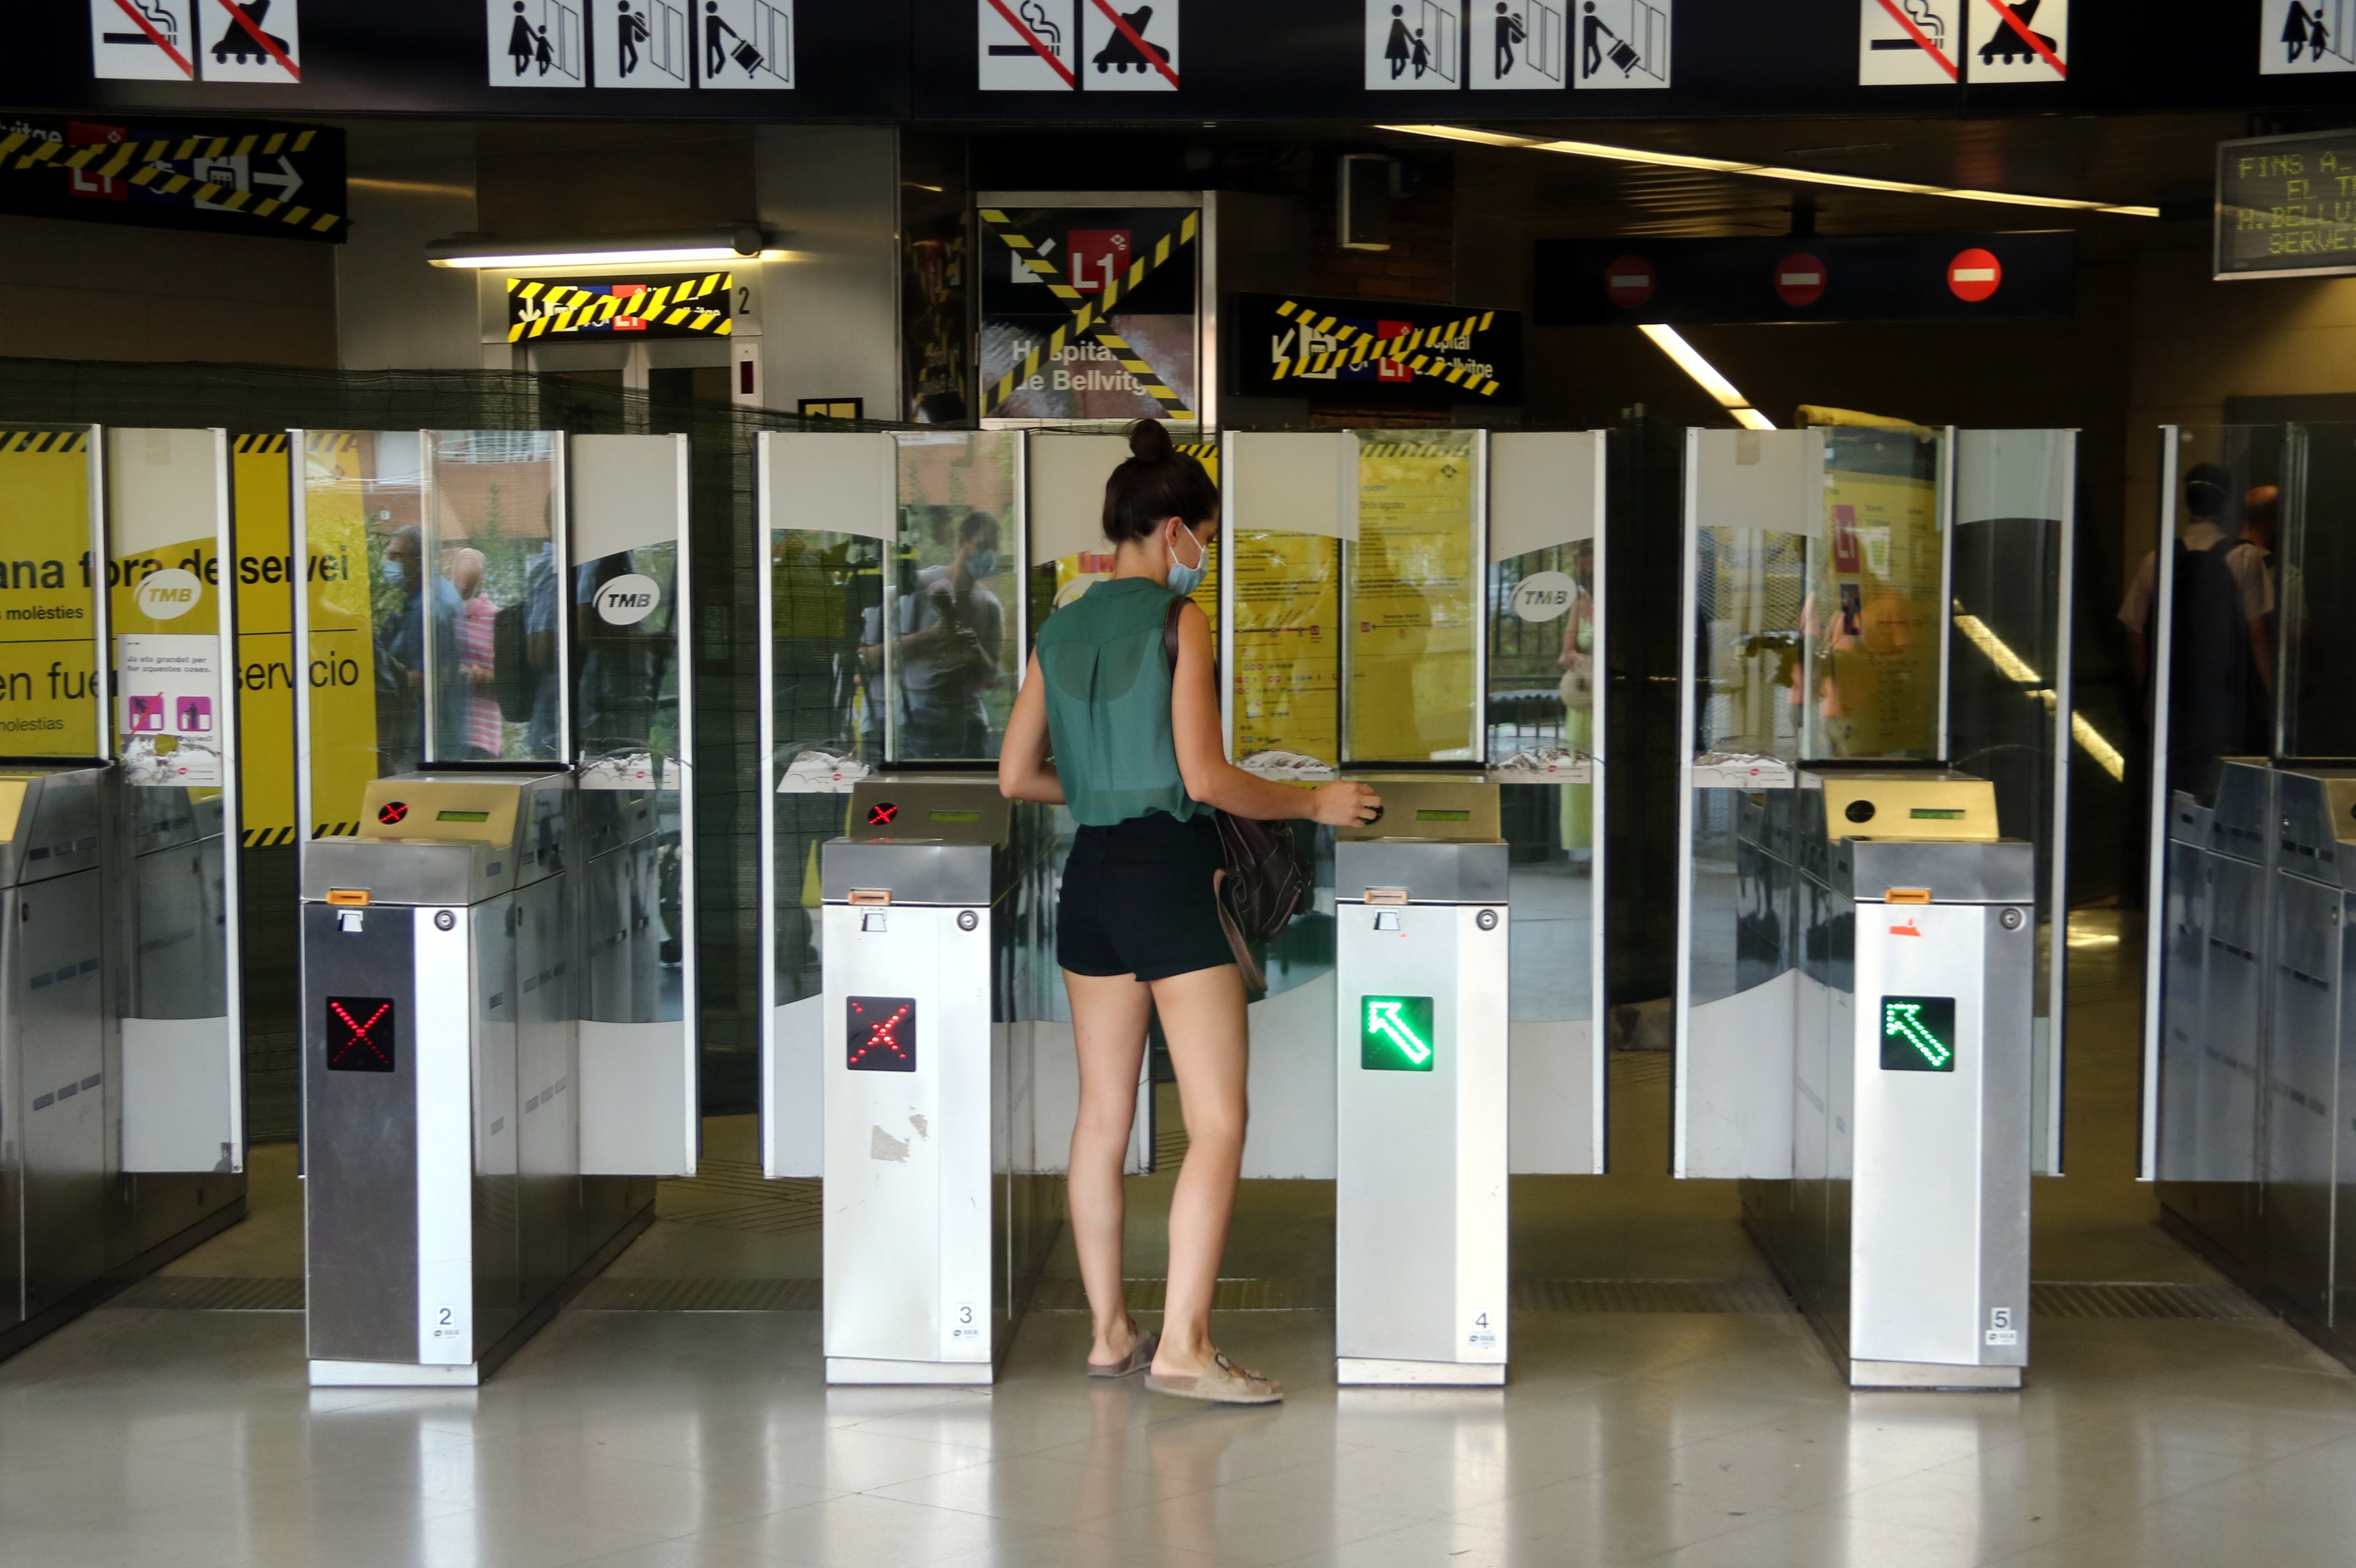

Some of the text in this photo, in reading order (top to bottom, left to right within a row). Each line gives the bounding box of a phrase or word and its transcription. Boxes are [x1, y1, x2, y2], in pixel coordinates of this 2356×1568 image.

[1072, 252, 1113, 288] L1
[738, 286, 750, 314] 2
[1012, 340, 1118, 366] Hspita
[1052, 369, 1148, 396] Bellvitg
[148, 587, 192, 603] TMB
[608, 593, 651, 608] TMB
[1524, 590, 1568, 606] TMB
[6, 605, 84, 620] molèsties
[235, 650, 358, 691] ervcio
[440, 1307, 452, 1325] 2
[960, 1306, 972, 1324] 3
[1475, 1312, 1489, 1329] 4
[1995, 1311, 2007, 1328] 5
